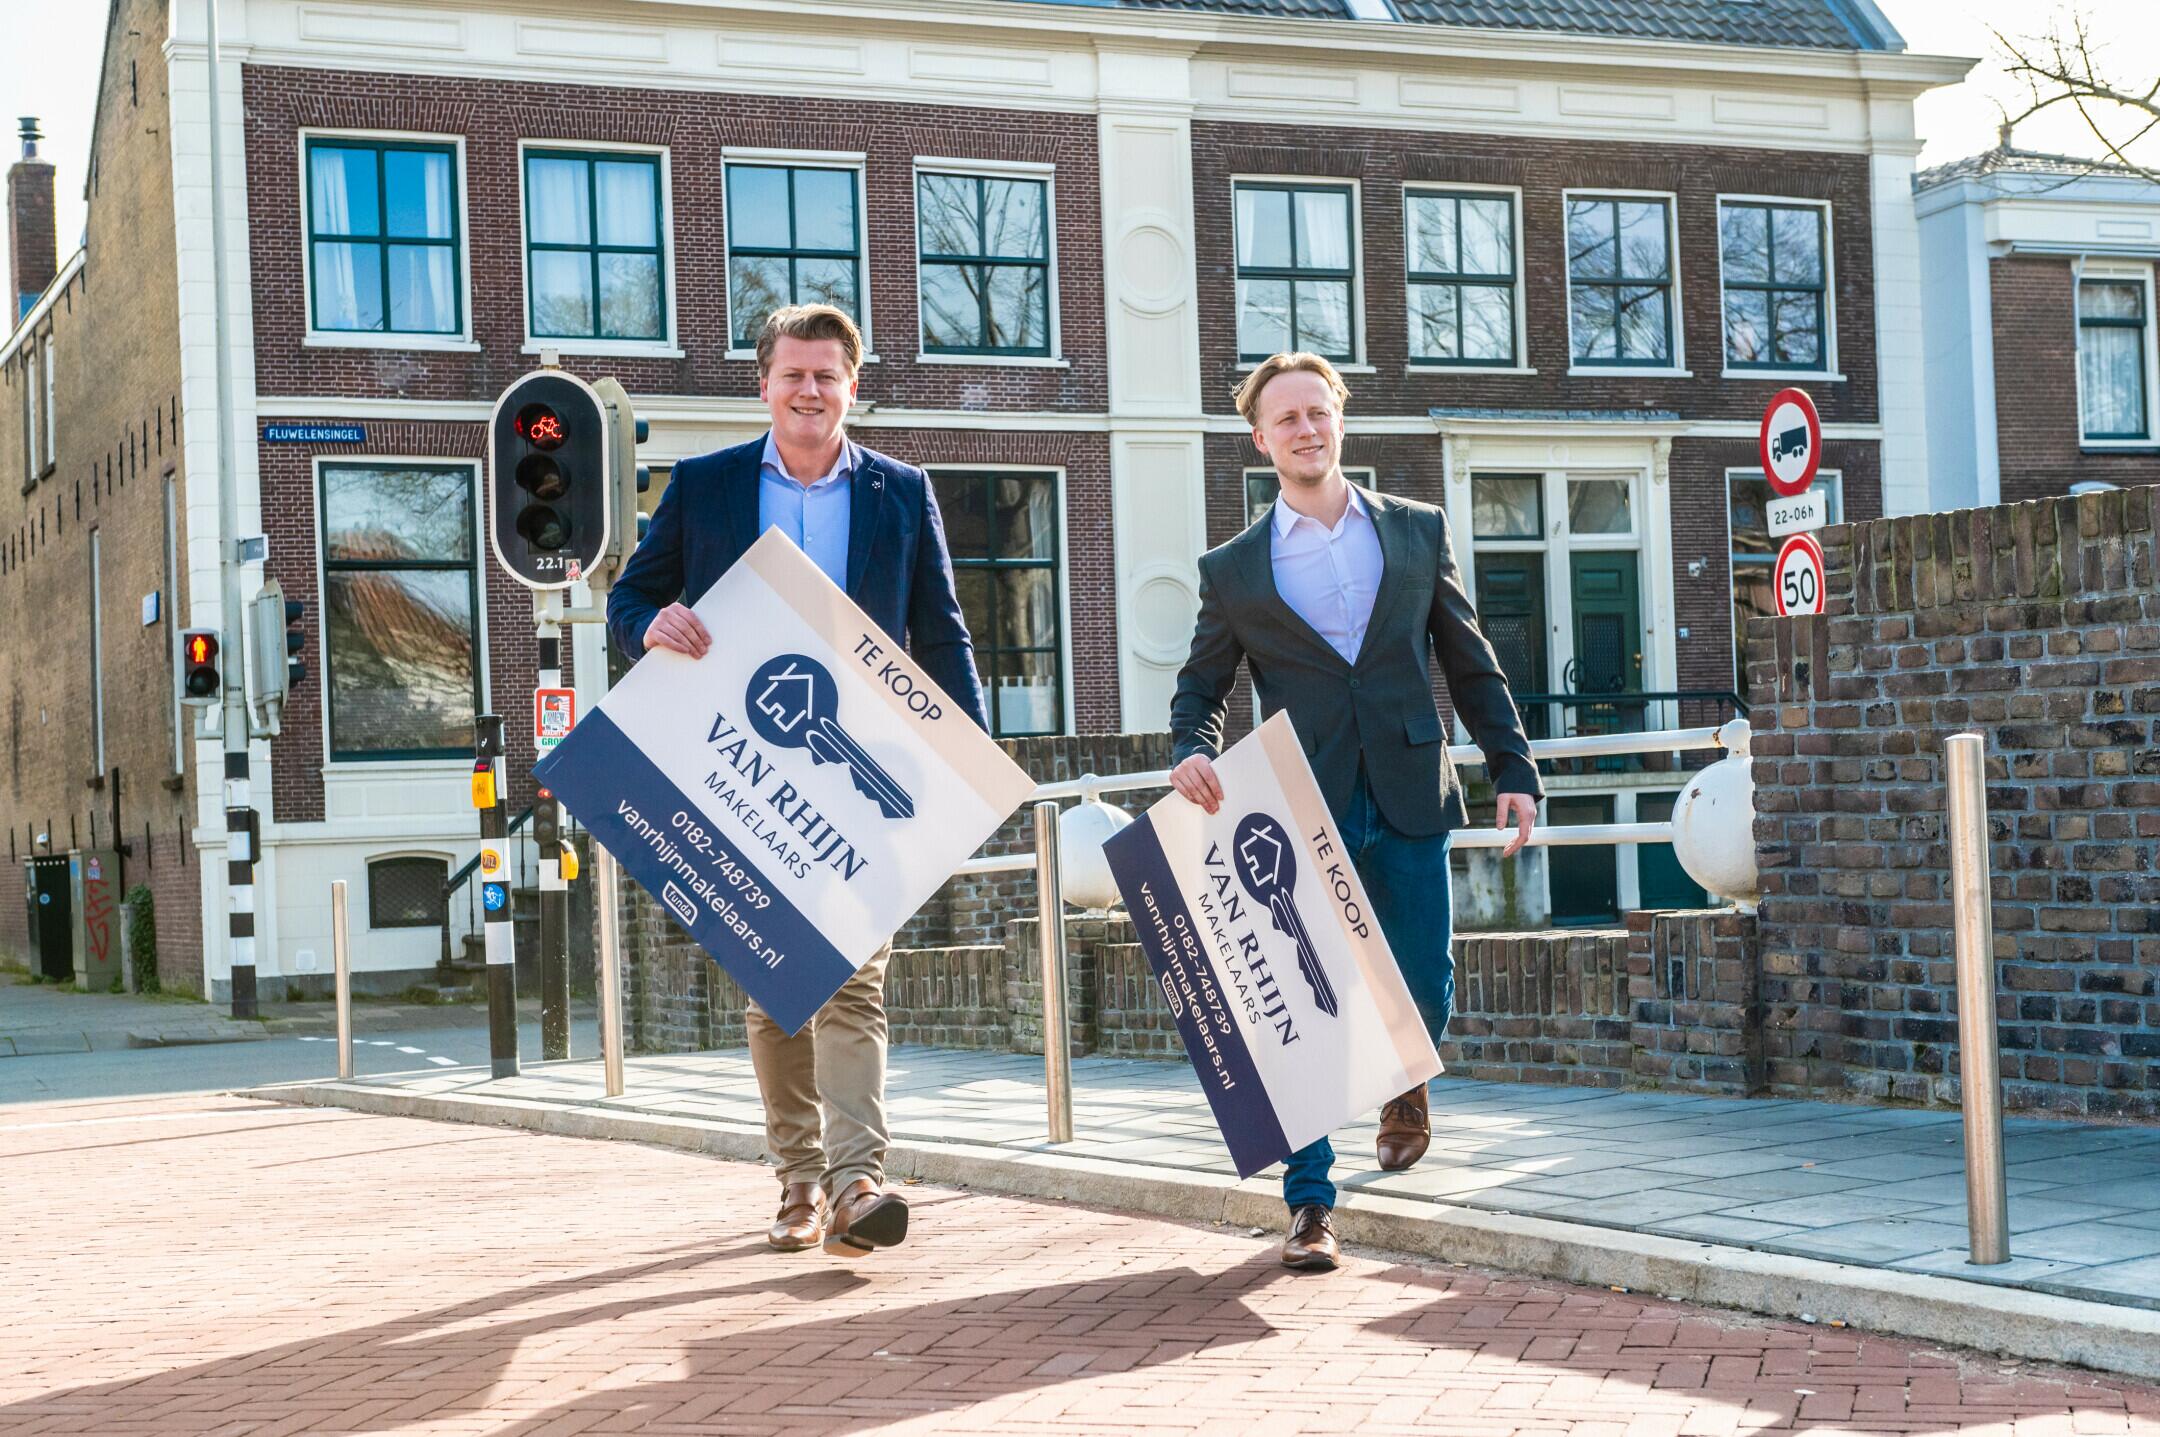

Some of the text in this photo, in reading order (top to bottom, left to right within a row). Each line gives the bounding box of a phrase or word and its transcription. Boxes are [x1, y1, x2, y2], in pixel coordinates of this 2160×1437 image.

[269, 428, 360, 440] FLUWELENSINGEL
[536, 556, 564, 570] 22.1
[1775, 504, 1814, 525] 22-06h
[1784, 567, 1815, 608] 50
[854, 633, 942, 720] TE KOOP
[541, 737, 565, 746] GRO
[704, 771, 811, 879] MAKELAARS
[706, 712, 869, 882] VAN RHIJN
[617, 800, 785, 970] vanrhijnmakelaars.nl
[667, 890, 692, 917] funda
[671, 811, 771, 910] 0182-748739
[1312, 826, 1369, 940] TE KOOP
[1140, 882, 1235, 1091] vanrhijnmakelaars.nl
[1174, 914, 1231, 1034] 0182-748739
[1198, 893, 1262, 1025] MAKELAARS
[1204, 840, 1301, 1046] VAN RHIJN
[1164, 980, 1180, 1009] funda
